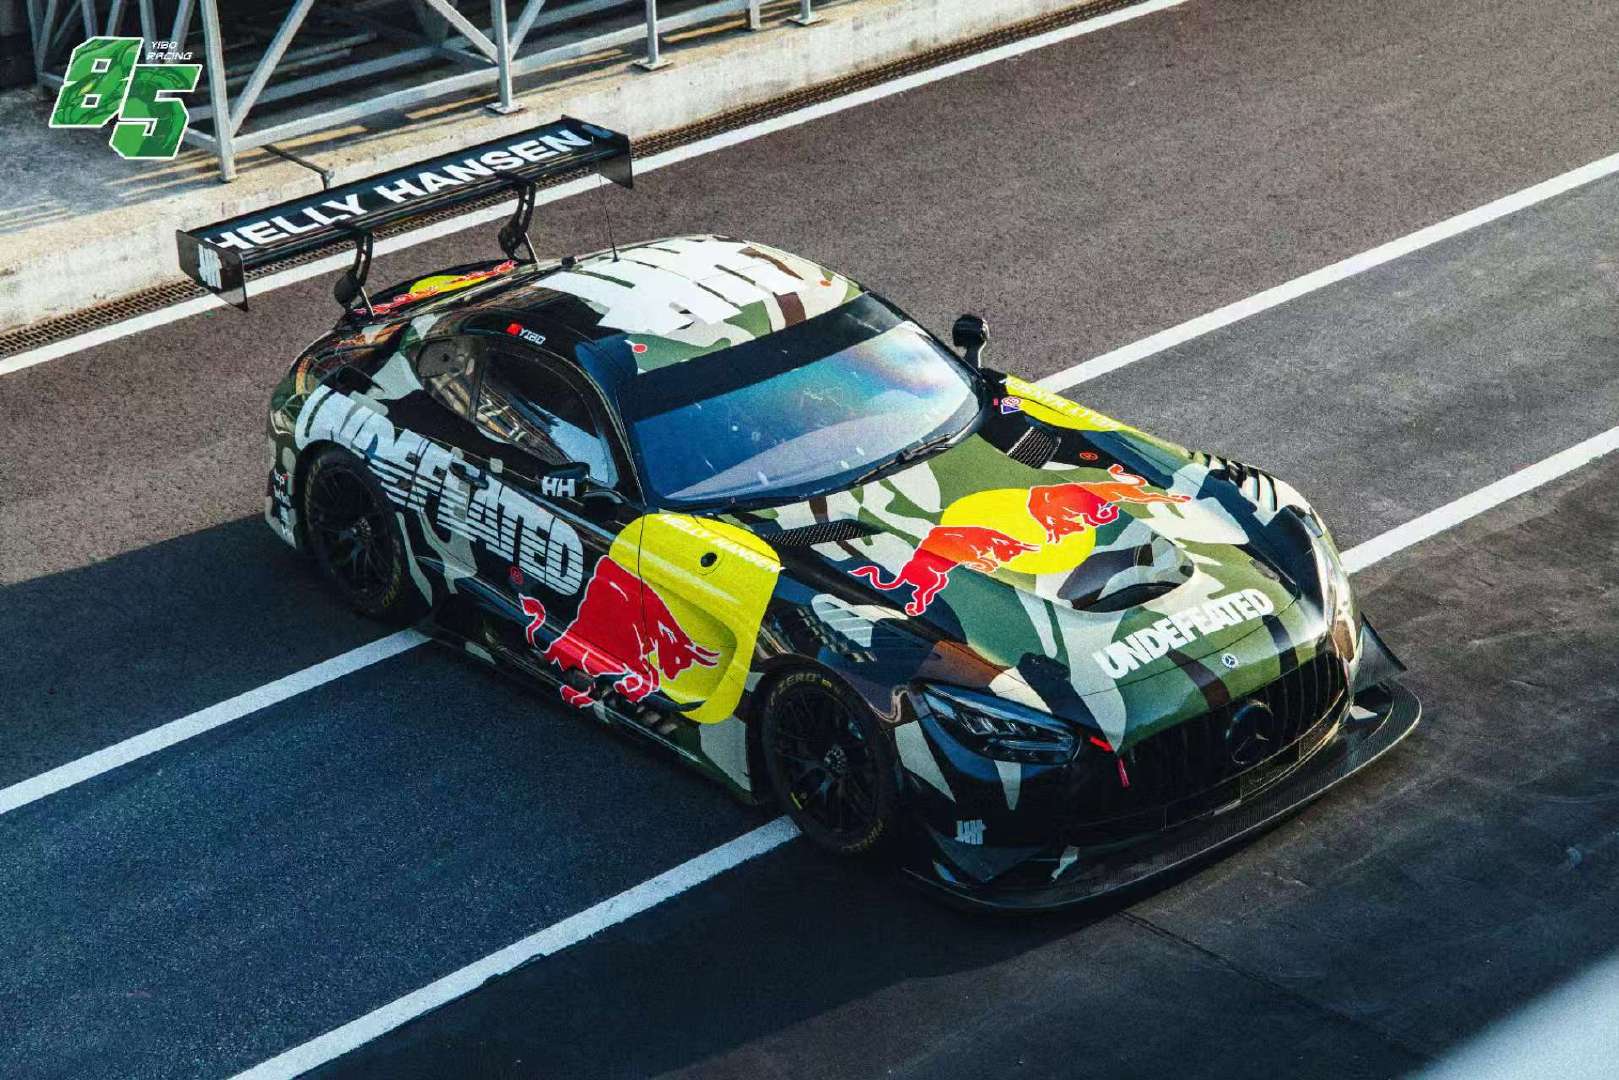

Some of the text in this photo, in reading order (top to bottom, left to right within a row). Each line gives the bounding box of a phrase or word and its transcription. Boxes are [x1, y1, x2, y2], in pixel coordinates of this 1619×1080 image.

[204, 129, 592, 250] HELLY HANSEN
[541, 475, 576, 497] HH
[1092, 588, 1274, 680] UNDEFEATED
